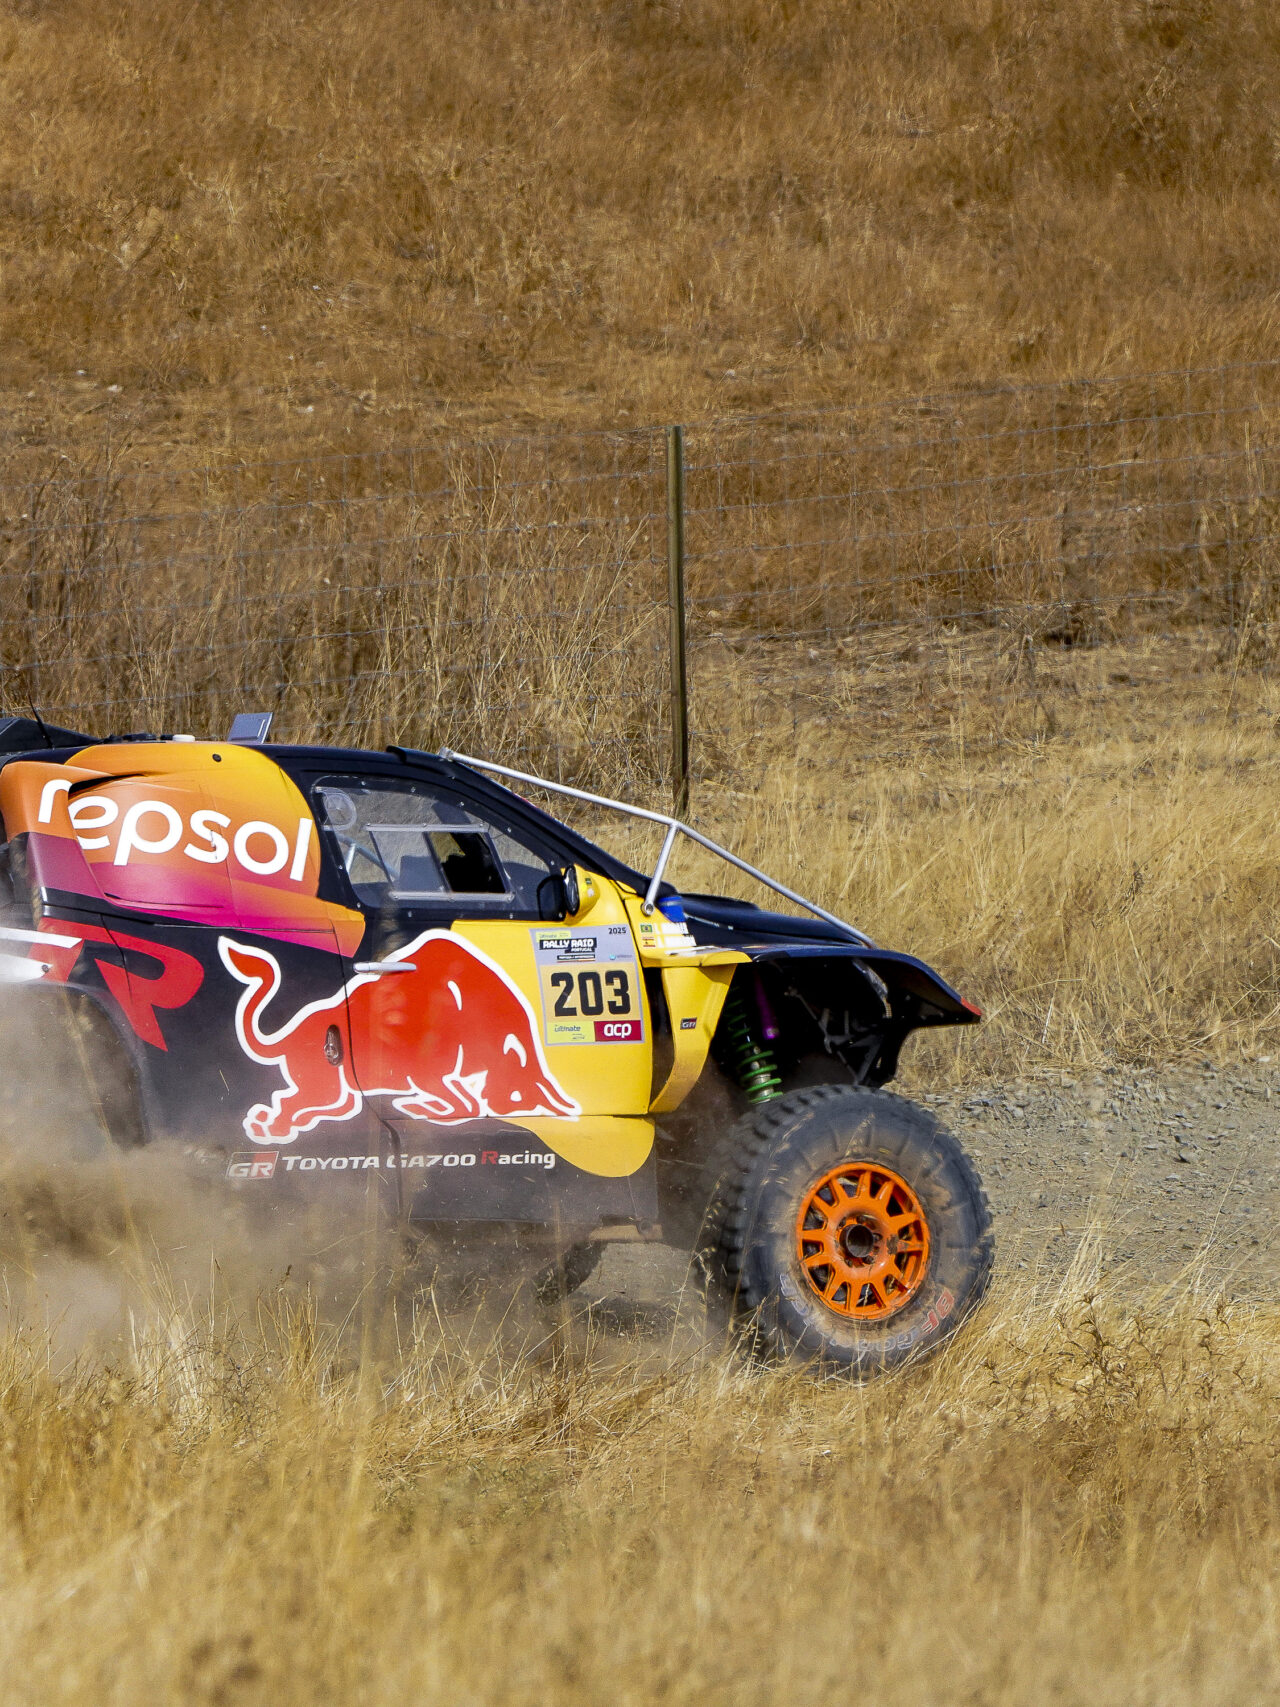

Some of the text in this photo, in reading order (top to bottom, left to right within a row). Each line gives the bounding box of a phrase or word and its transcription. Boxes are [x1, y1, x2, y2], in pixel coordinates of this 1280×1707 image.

[38, 778, 313, 882] repsol
[608, 926, 627, 935] 2025
[542, 938, 594, 949] RALLY RAID
[550, 970, 631, 1017] 203
[603, 1023, 632, 1038] acp
[228, 1151, 556, 1178] GR TOYOTA GAZOO Racing
